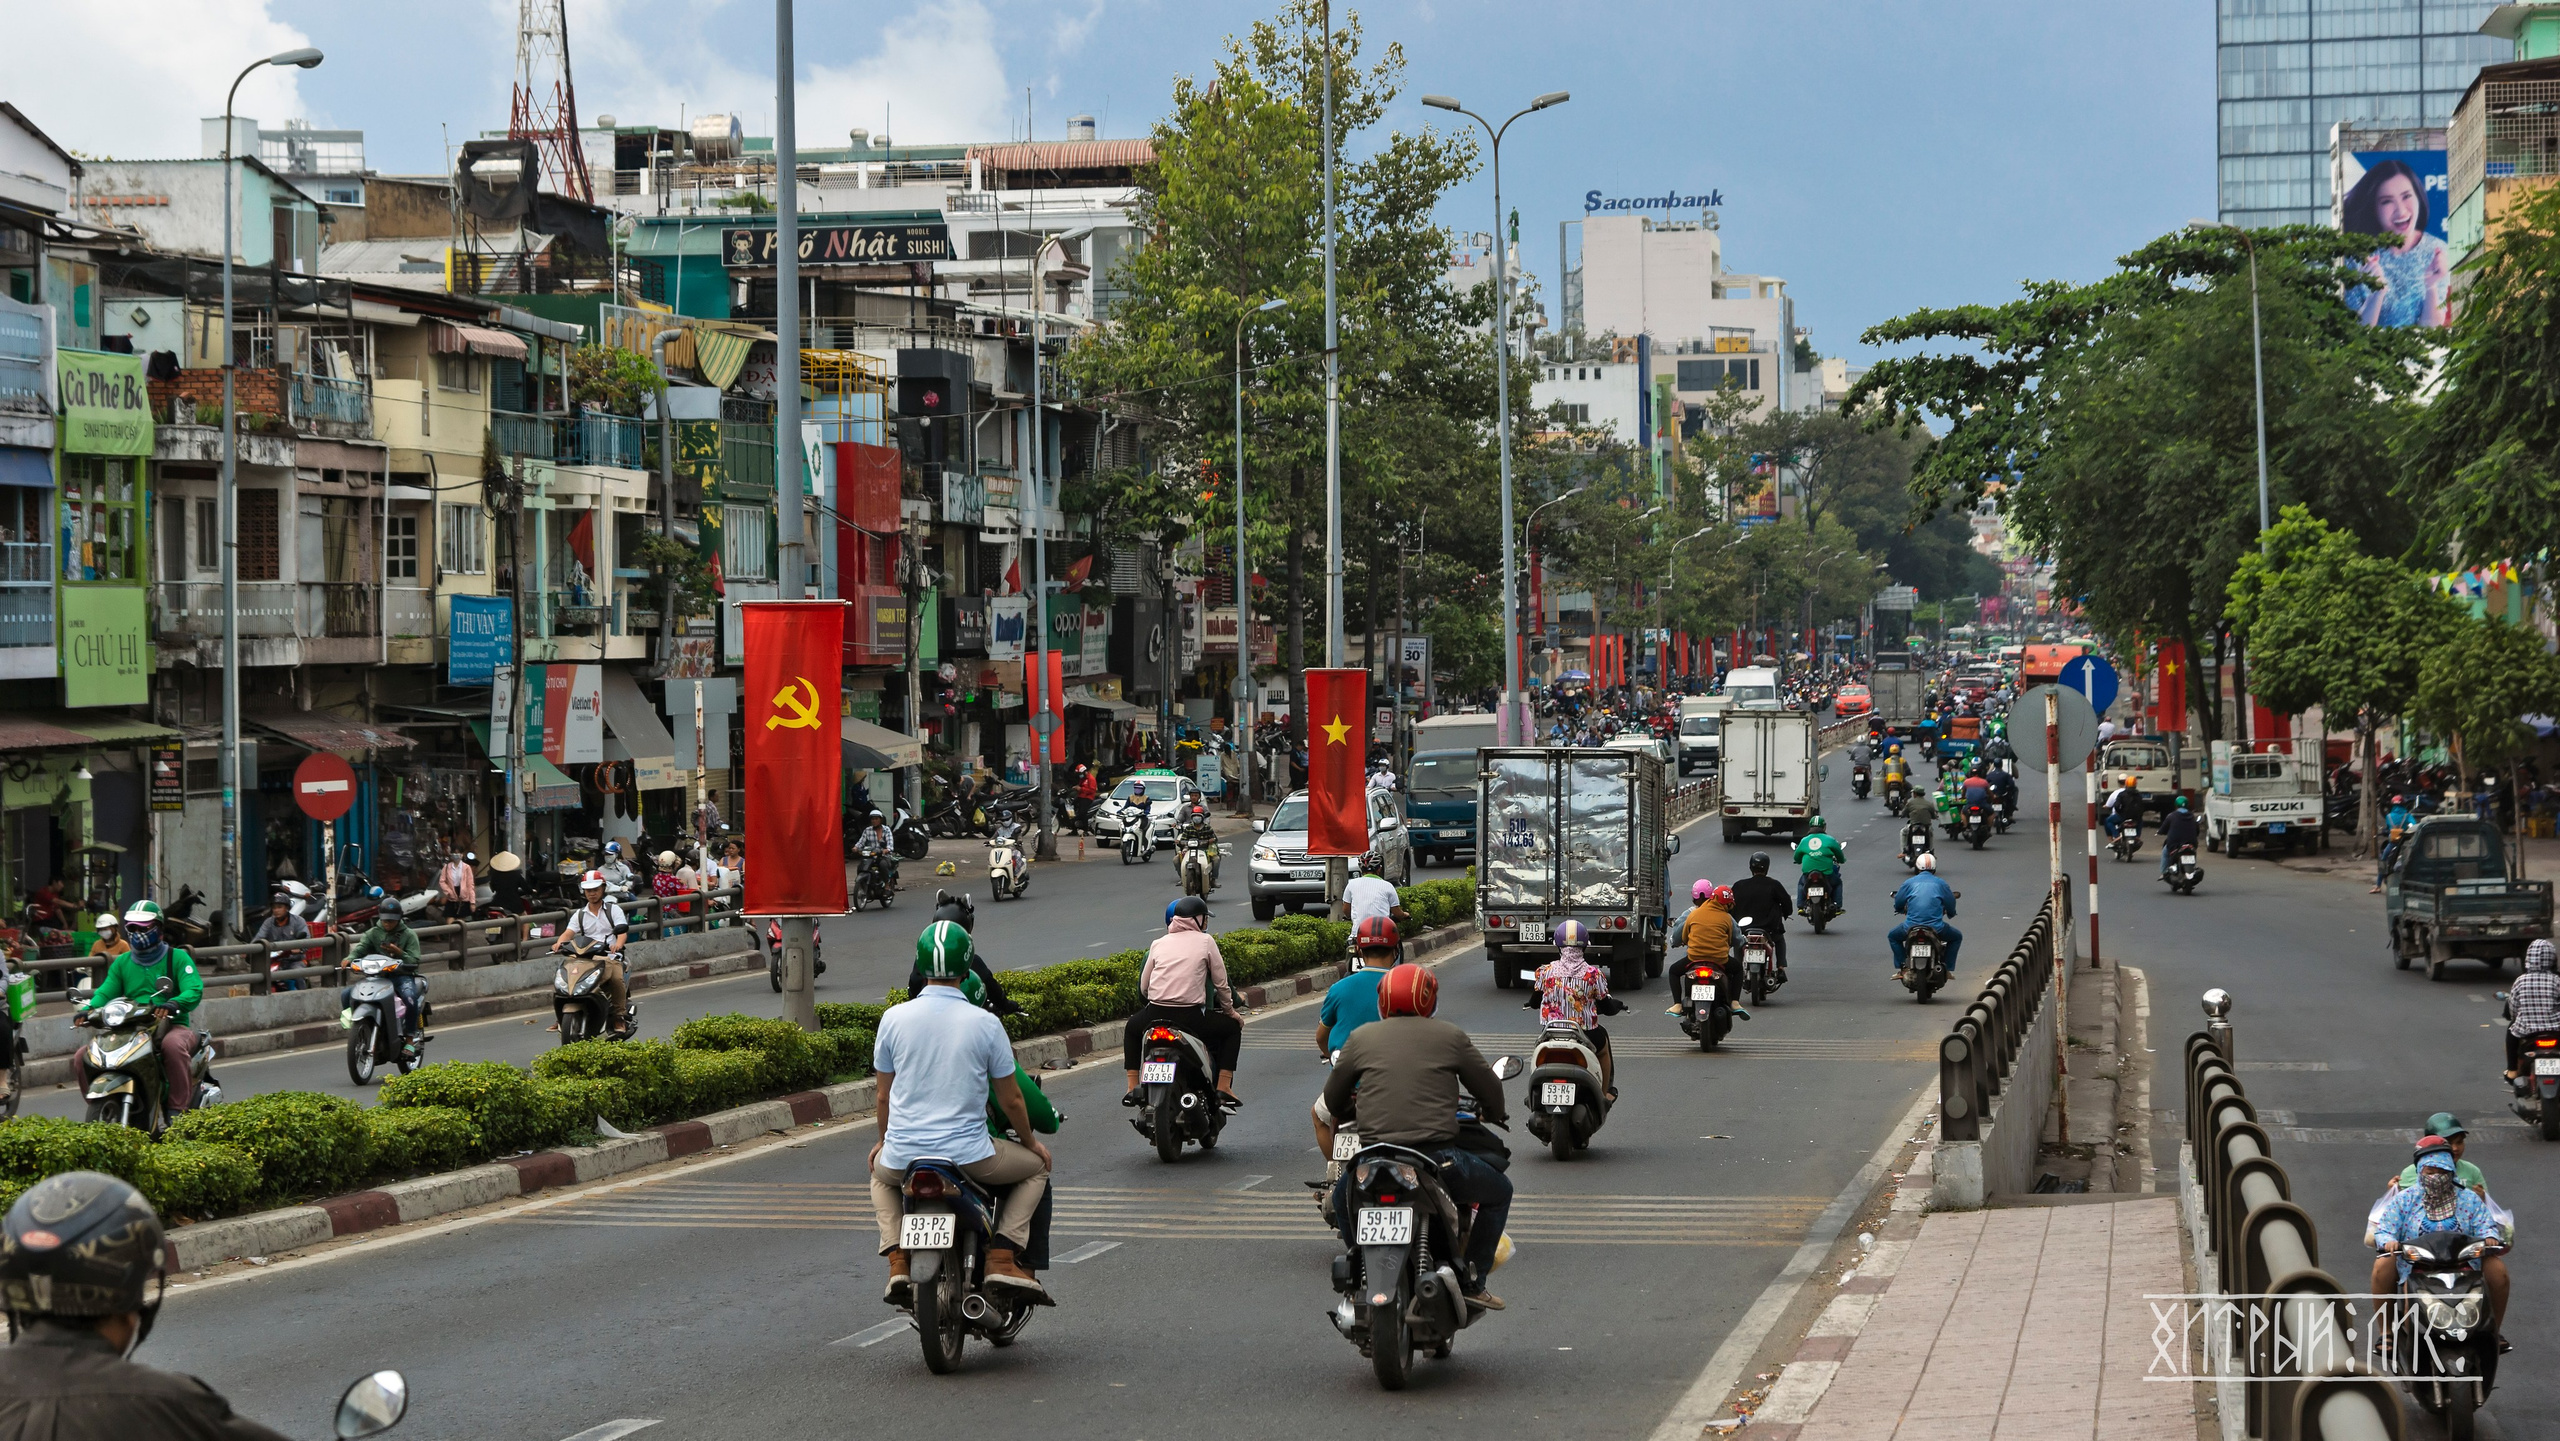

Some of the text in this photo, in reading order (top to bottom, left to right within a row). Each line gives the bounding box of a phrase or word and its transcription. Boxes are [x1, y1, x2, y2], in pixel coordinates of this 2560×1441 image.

[1584, 189, 1724, 212] Sacombank
[824, 228, 898, 261] Nhật
[907, 239, 945, 254] SUSHI
[65, 368, 86, 407] Cà
[88, 371, 119, 409] Phê
[84, 422, 99, 438] SINH
[455, 608, 495, 635] THU VÂN
[74, 627, 138, 667] CHÚ HÍ
[572, 696, 592, 710] Vietlott
[2250, 802, 2304, 813] SUZUKI
[1510, 818, 1527, 833] 51D
[1503, 833, 1534, 848] 143.63
[1525, 923, 1540, 932] 51D
[1521, 932, 1545, 941] 143.63
[1147, 1064, 1170, 1073] 67-L1
[1143, 1073, 1173, 1082] 833.56
[1547, 1084, 1571, 1095] 53-R4
[1546, 1094, 1570, 1103] 1313
[911, 1217, 947, 1230] 93-P2
[1367, 1211, 1403, 1225] 59-H1
[905, 1232, 950, 1246] 181.05
[1361, 1227, 1408, 1242] 524.27
